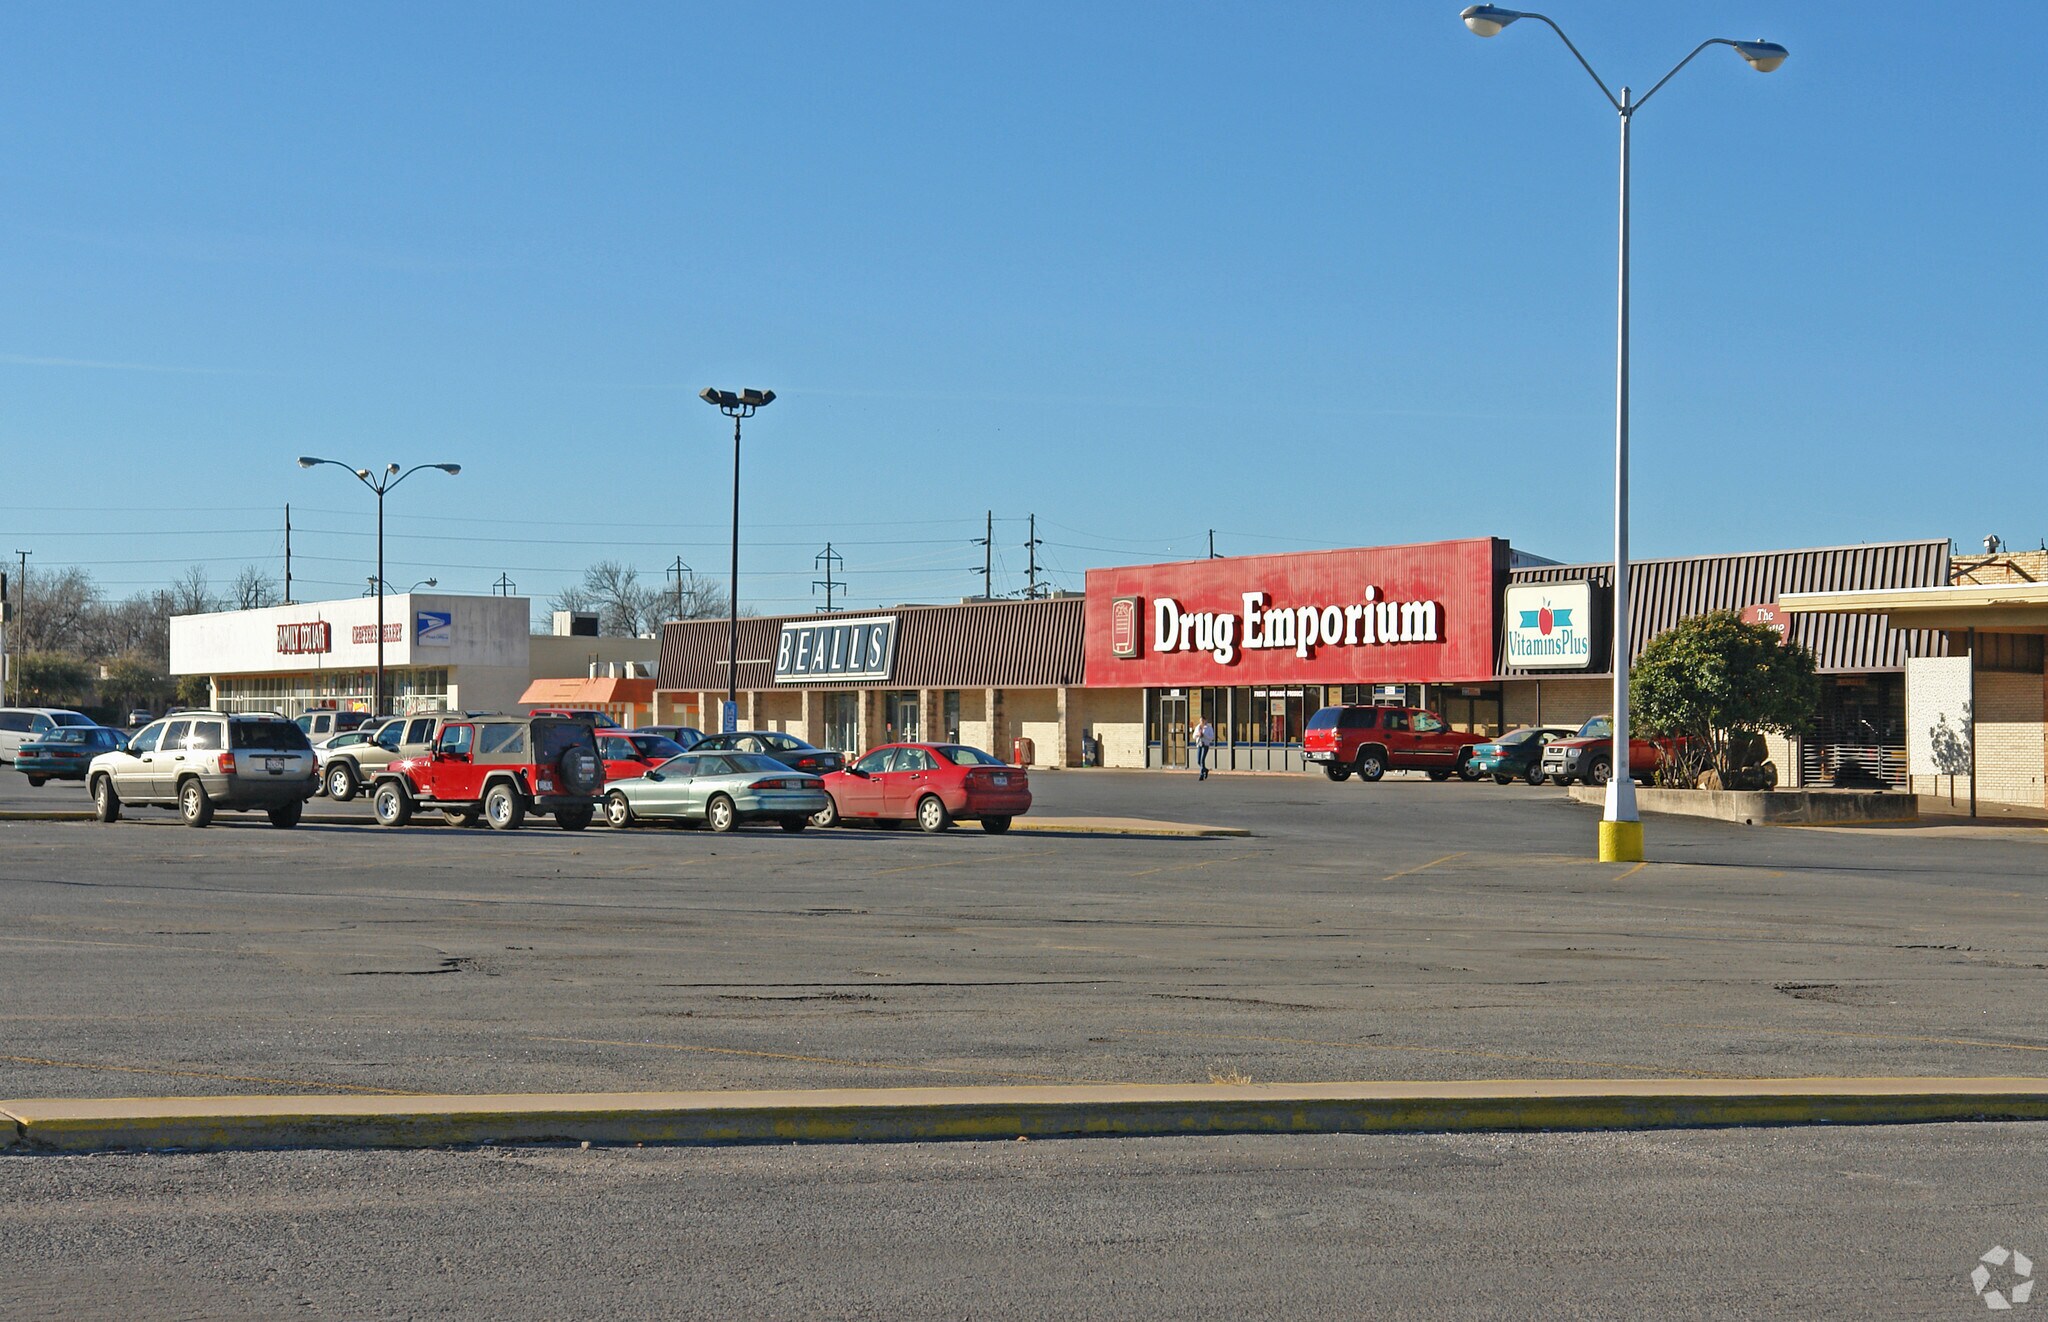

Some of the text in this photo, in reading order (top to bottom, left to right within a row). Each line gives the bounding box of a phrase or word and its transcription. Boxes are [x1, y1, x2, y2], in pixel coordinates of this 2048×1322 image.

[1153, 584, 1437, 664] Drug Emporium
[1757, 608, 1774, 621] The
[777, 627, 883, 671] BEALLS
[1508, 629, 1588, 656] VitaminsPlus
